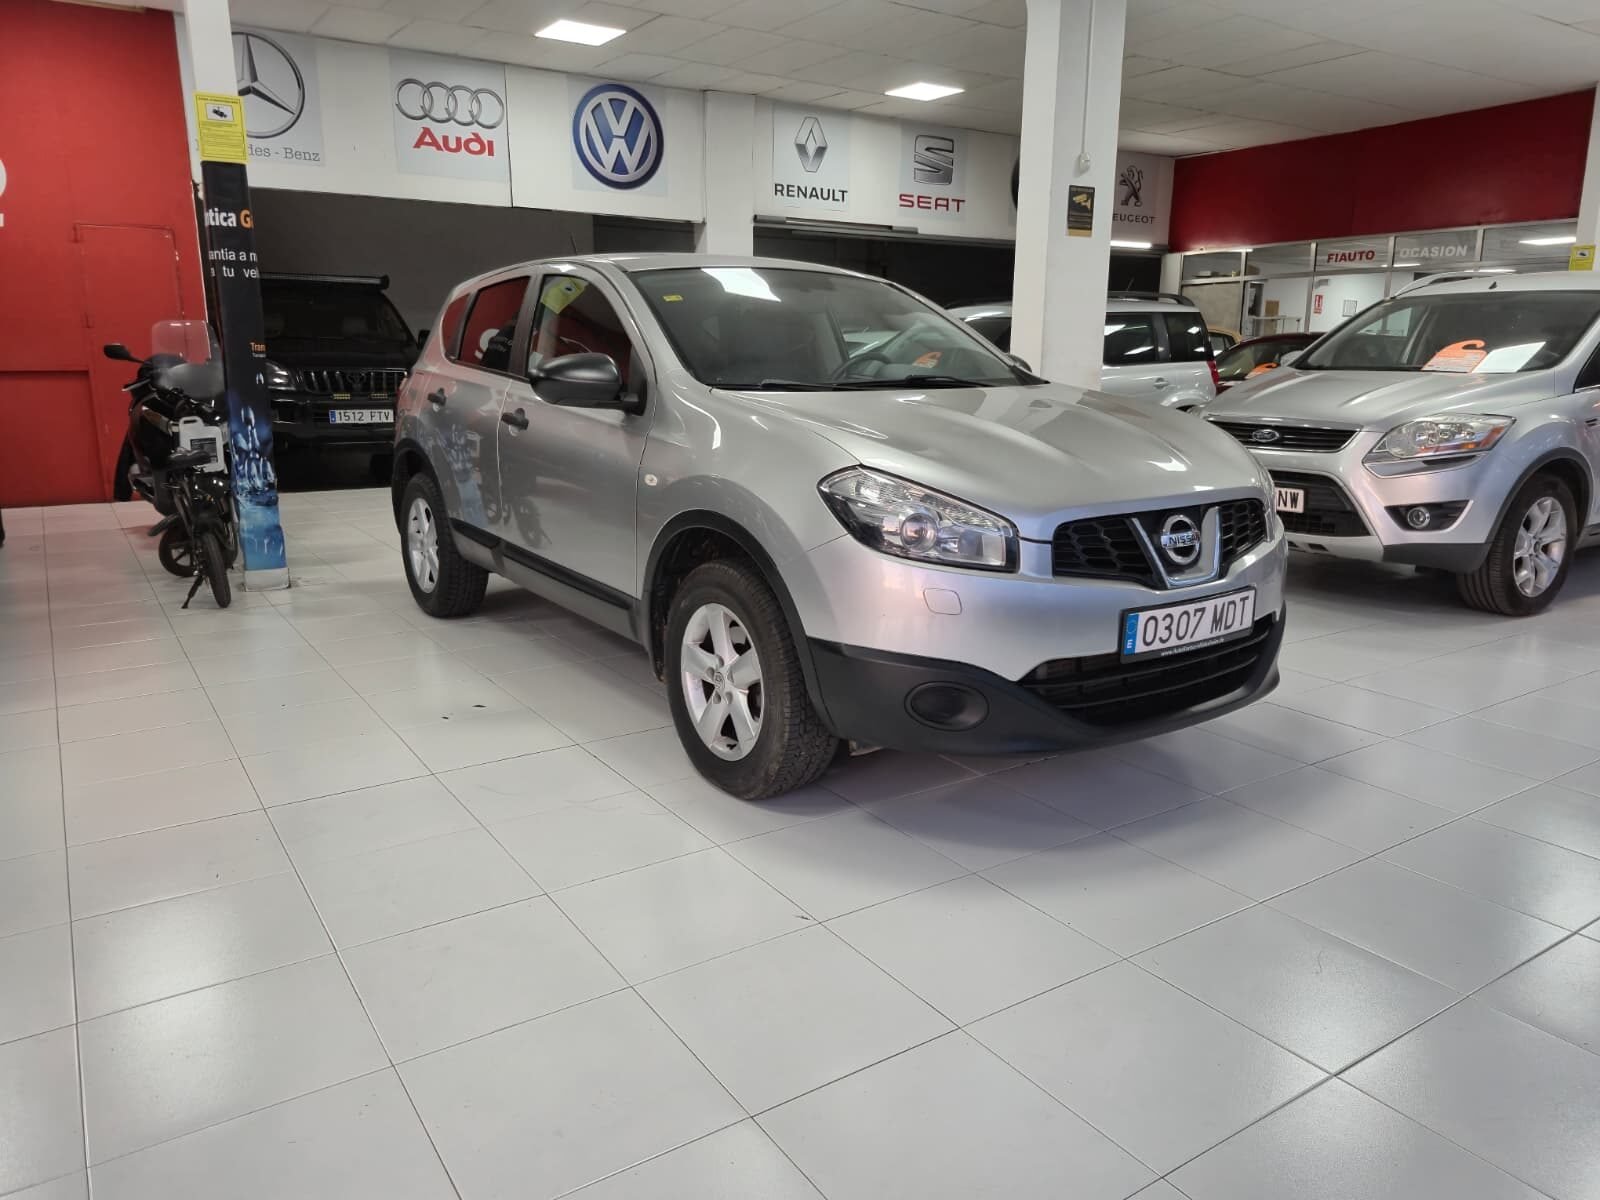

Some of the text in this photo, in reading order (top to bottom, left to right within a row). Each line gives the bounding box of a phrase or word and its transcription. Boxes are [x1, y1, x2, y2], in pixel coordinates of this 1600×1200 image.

[412, 126, 494, 157] Audi
[282, 146, 320, 162] Benz
[774, 183, 848, 203] RENAULT
[899, 193, 966, 213] SEAT
[240, 209, 254, 229] G
[1111, 213, 1156, 225] EUGEOT
[1327, 250, 1376, 264] FIAUTO
[1400, 245, 1468, 259] OCASION
[222, 265, 235, 278] tu
[338, 411, 390, 422] 1512 FTV
[1277, 490, 1299, 509] NW
[1142, 596, 1249, 647] 0307 MDT
